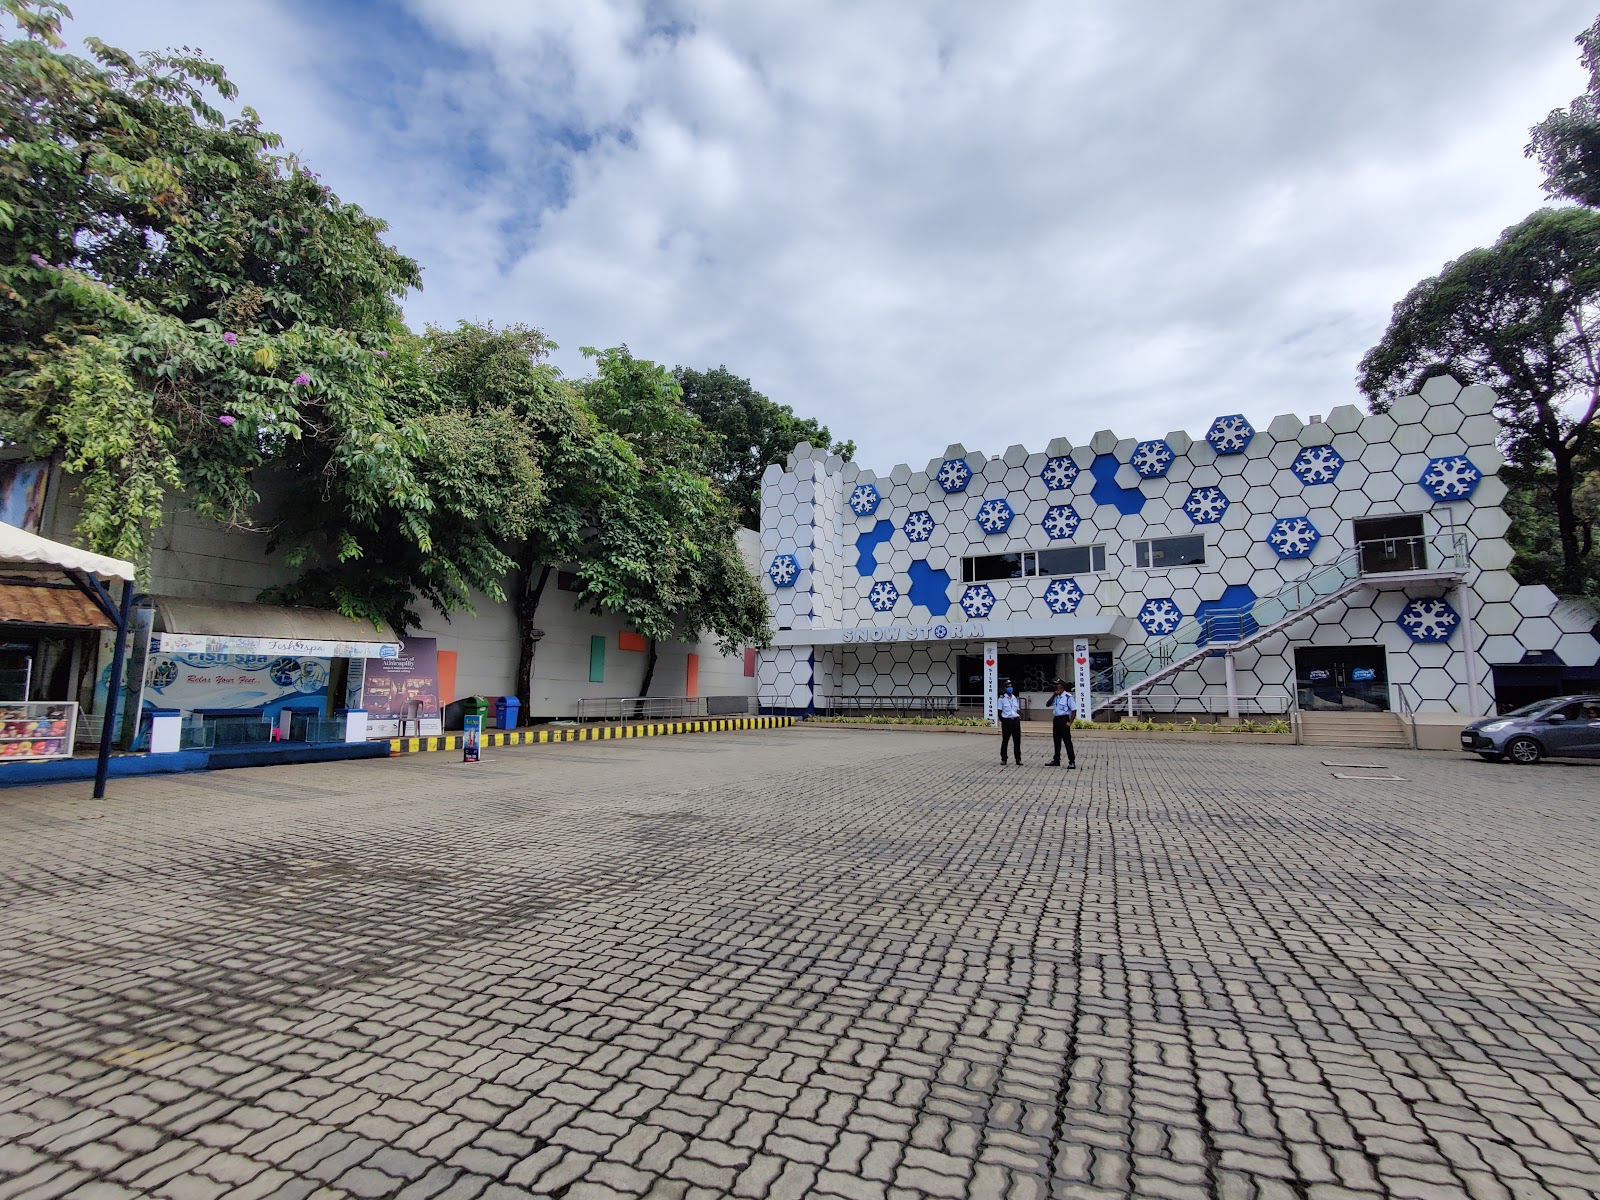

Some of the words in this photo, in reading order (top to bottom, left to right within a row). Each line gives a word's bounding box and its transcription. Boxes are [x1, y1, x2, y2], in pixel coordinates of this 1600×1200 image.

[842, 627, 901, 642] SNOW
[268, 641, 296, 650] Fish
[186, 674, 211, 683] Relax
[215, 675, 235, 684] Your
